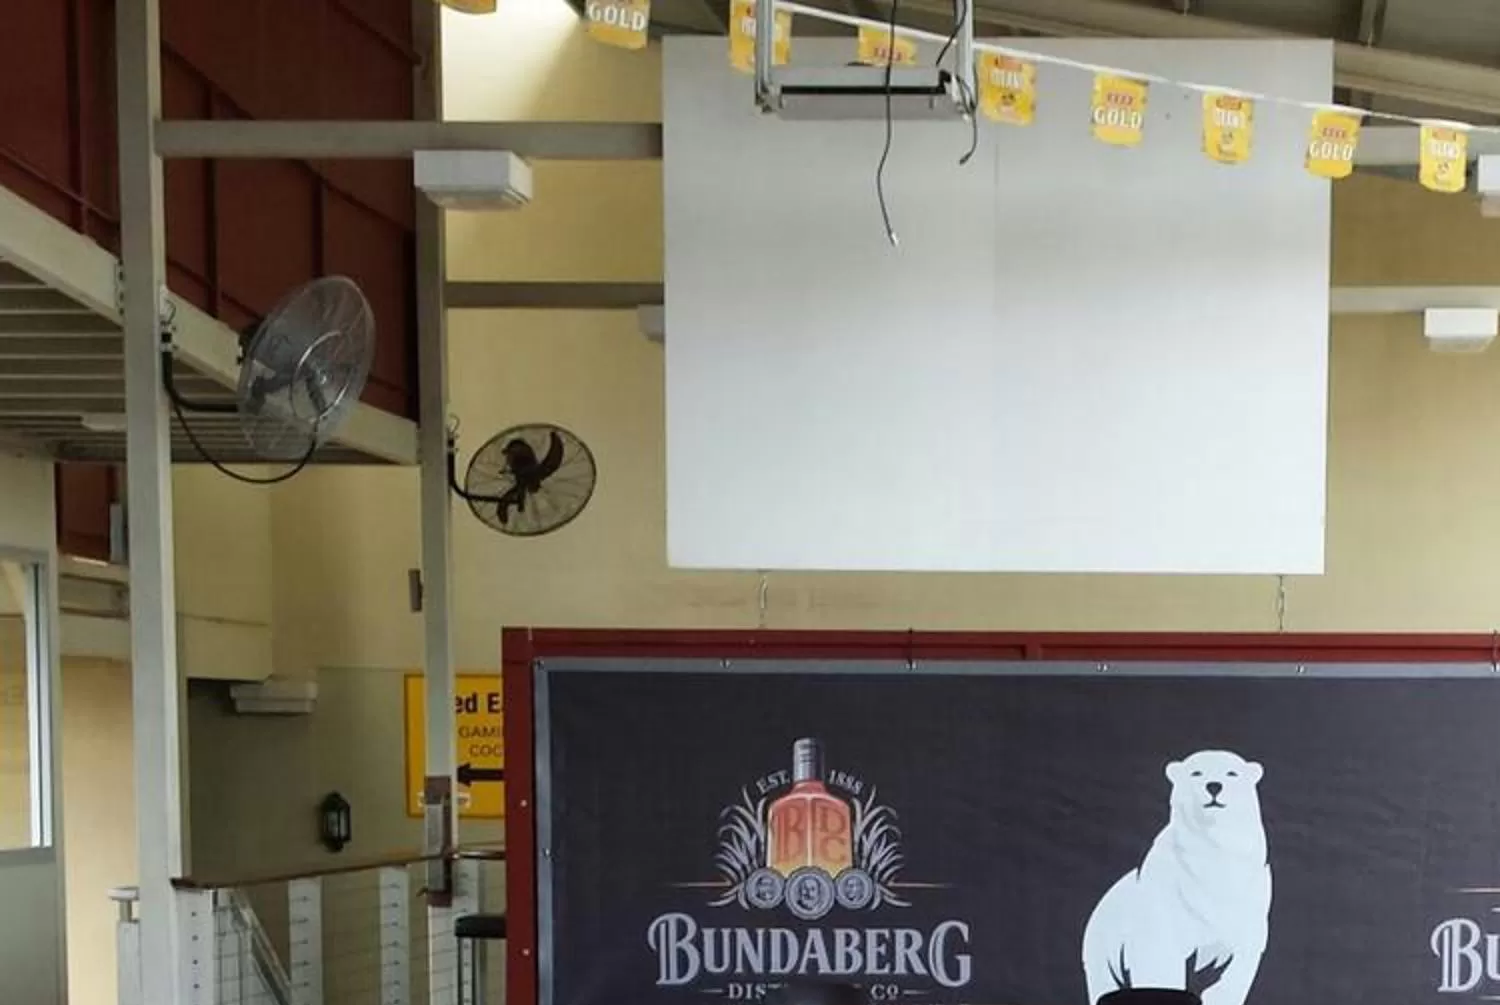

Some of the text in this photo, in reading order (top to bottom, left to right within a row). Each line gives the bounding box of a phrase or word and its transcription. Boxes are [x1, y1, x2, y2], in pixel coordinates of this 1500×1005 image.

[588, 2, 646, 32] GOLD
[1093, 106, 1144, 130] GOLD
[1308, 138, 1354, 162] GOLD
[455, 692, 477, 714] ed
[647, 912, 972, 988] BUNDABERG
